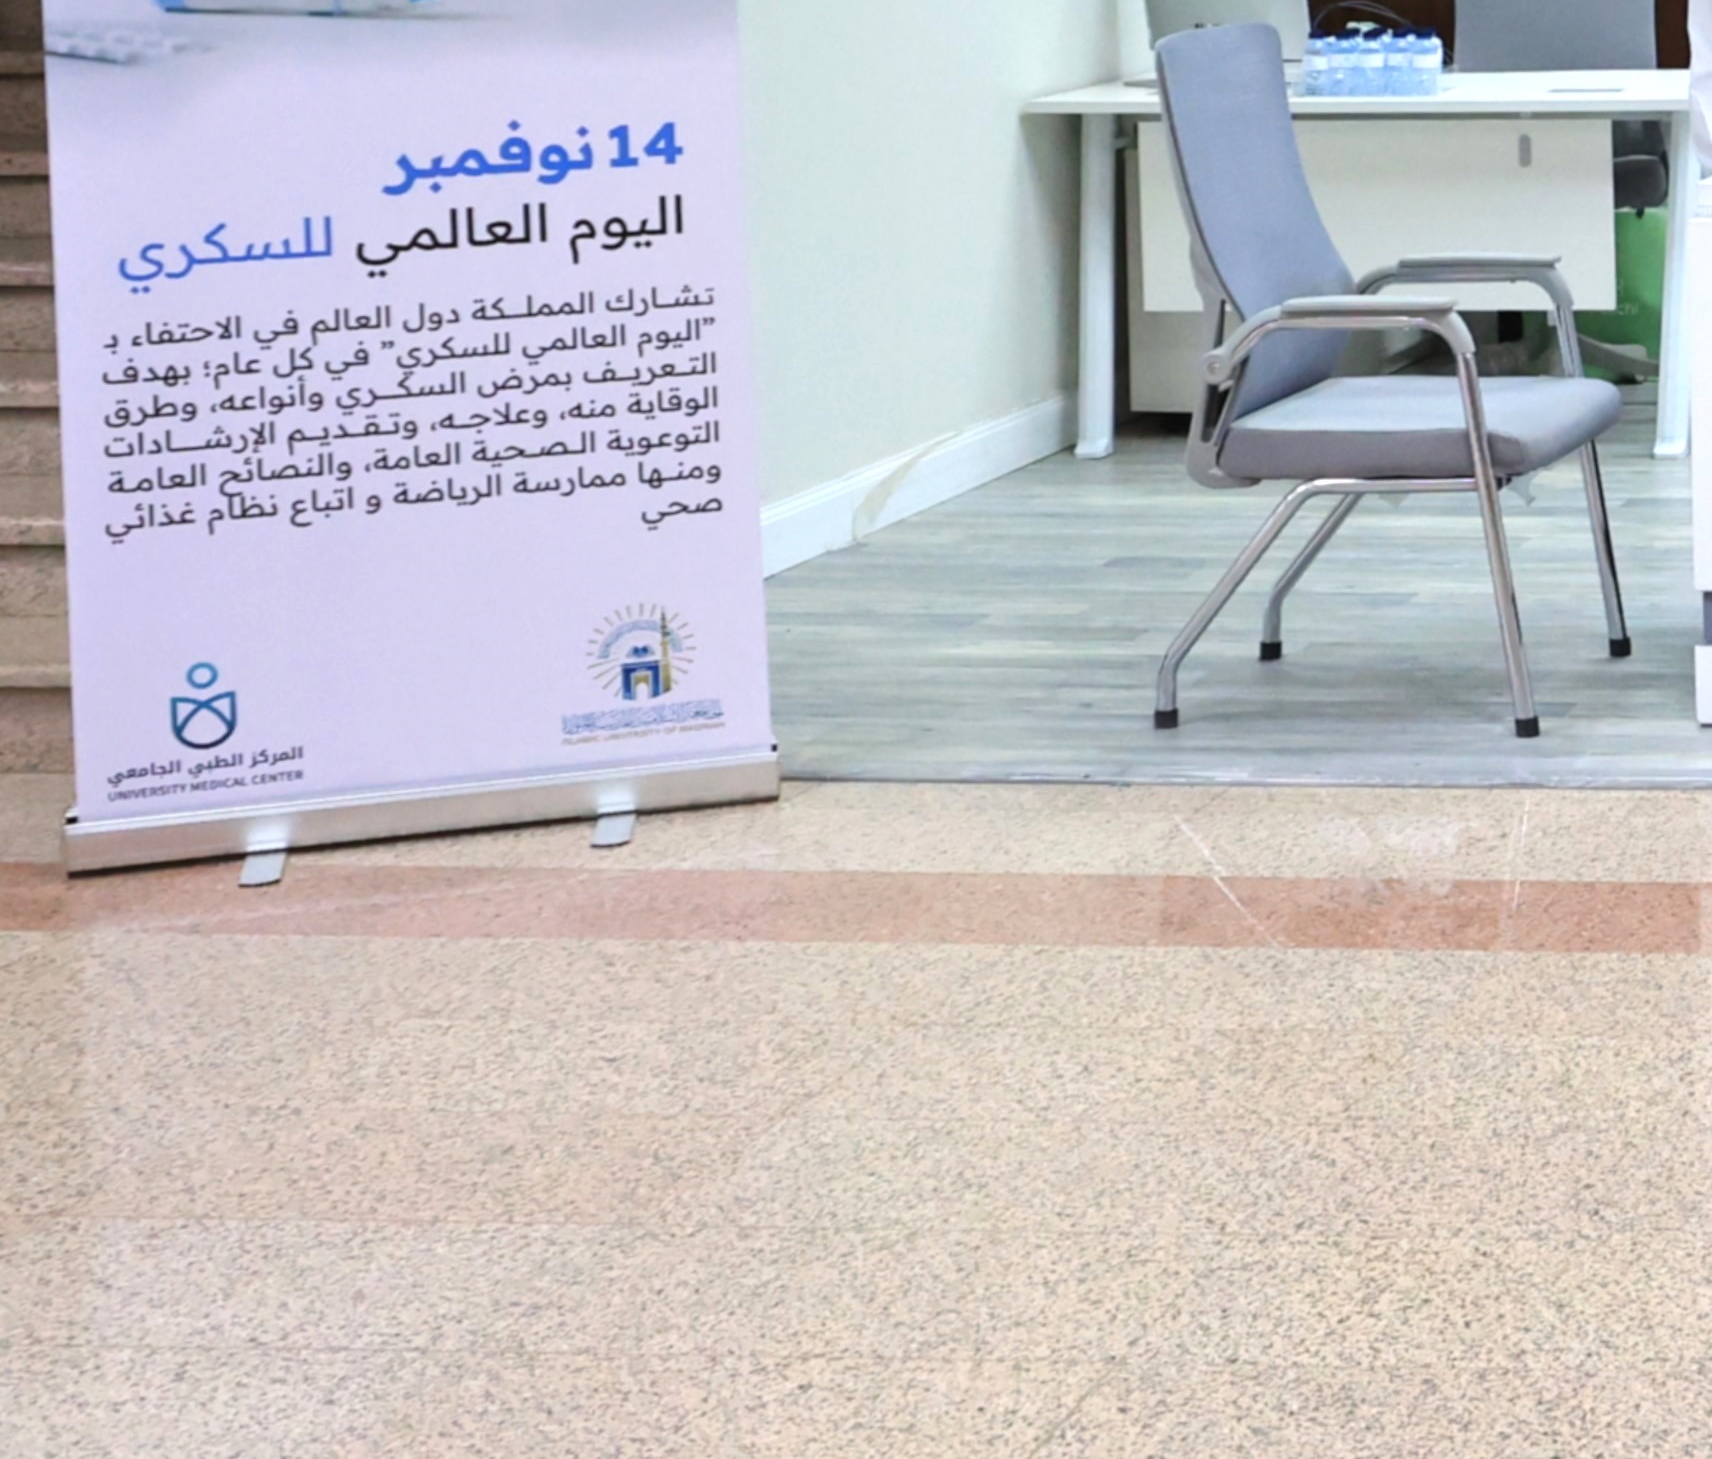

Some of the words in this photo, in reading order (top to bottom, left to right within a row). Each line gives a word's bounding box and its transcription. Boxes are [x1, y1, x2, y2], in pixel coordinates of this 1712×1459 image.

[381, 119, 594, 197] نوفمبر
[607, 121, 684, 169] 14
[355, 202, 548, 279] العالمي
[569, 193, 684, 265] اليوم
[118, 215, 333, 295] للسكري
[470, 290, 594, 321] المملكة
[604, 284, 714, 314] تشارك
[130, 314, 242, 347] الاحتفاء
[252, 316, 299, 344] في
[309, 304, 391, 346] العالم
[401, 302, 461, 334] دول
[323, 340, 370, 380] في
[521, 322, 627, 366] العالمي
[101, 357, 192, 388] بهدف
[271, 345, 314, 379] كل
[581, 350, 717, 384] التعريف
[334, 370, 466, 416] السكري
[476, 368, 572, 399] بمرض
[103, 393, 198, 429] وطرق
[626, 385, 718, 420] الوقاية
[103, 420, 276, 459] الإرشادات
[286, 411, 419, 450] وتقديم
[606, 419, 720, 457] التوعوية
[470, 430, 596, 468] الصحية
[107, 462, 207, 494] العامة
[218, 452, 354, 496] والنصائح
[392, 472, 502, 507] الرياضة
[512, 467, 627, 497] ممارسة
[637, 460, 722, 490] ومنها
[207, 493, 279, 536] نظام
[289, 485, 354, 528] اتباع
[364, 493, 382, 515] و
[640, 496, 723, 531] صحي
[104, 501, 196, 545] غذائي
[106, 759, 182, 789] الجامعي
[187, 752, 244, 779] الطبي
[248, 745, 304, 769] المركز
[107, 783, 188, 803] UNIVERSITY
[189, 776, 248, 792] MEDICAL
[250, 769, 304, 786] CENTER
